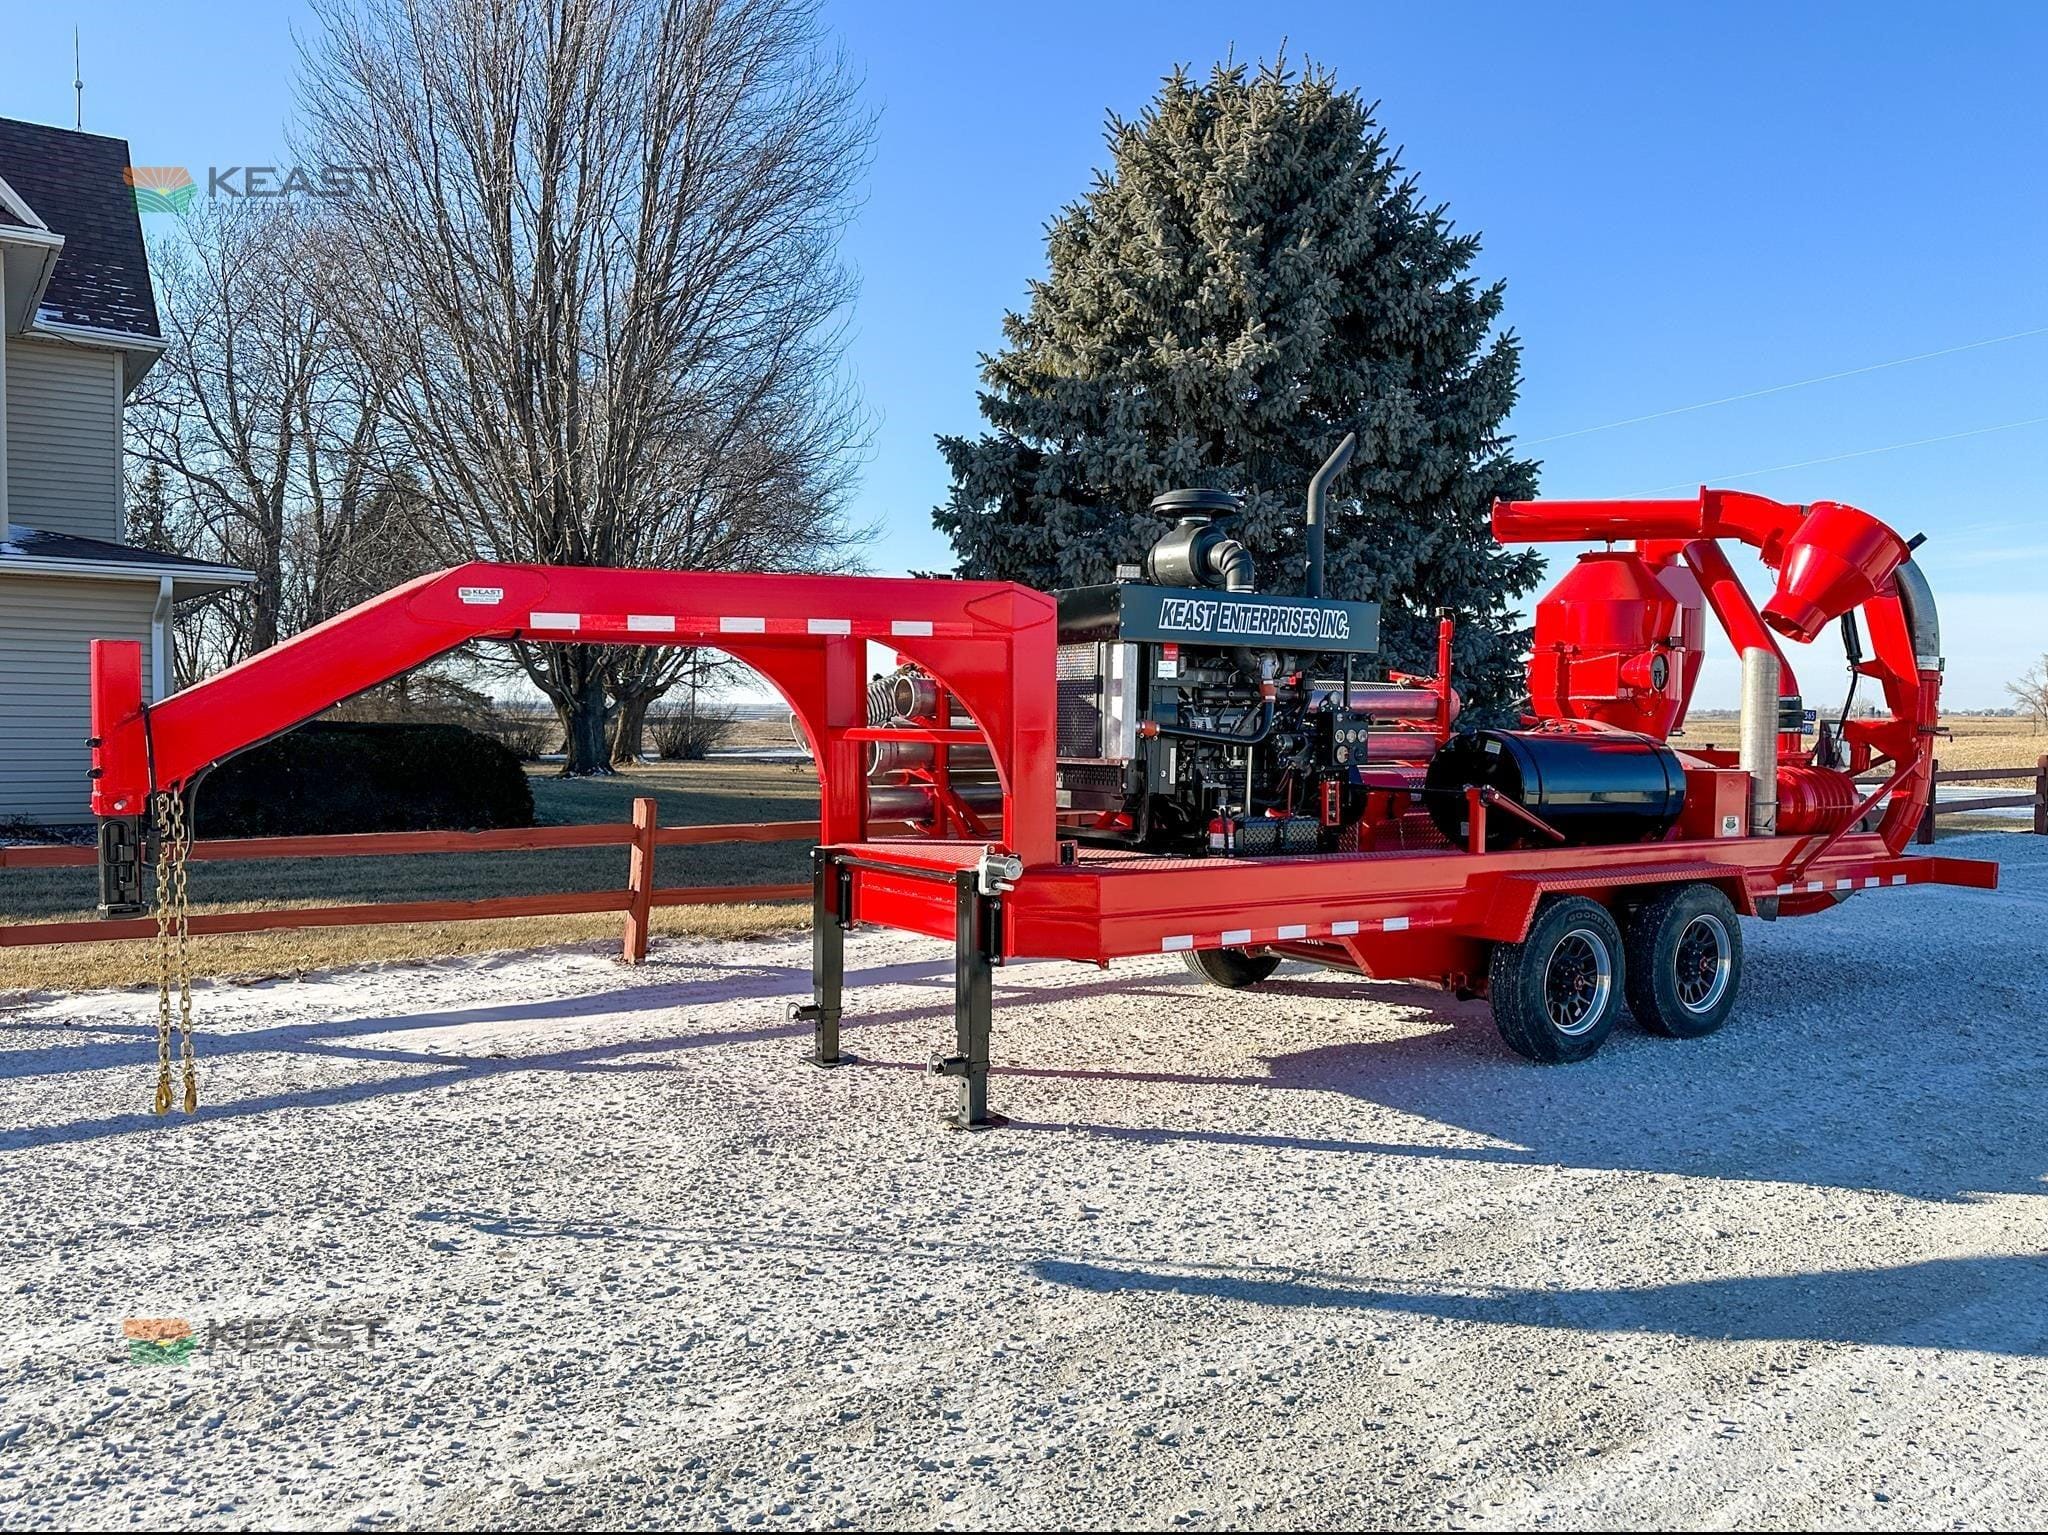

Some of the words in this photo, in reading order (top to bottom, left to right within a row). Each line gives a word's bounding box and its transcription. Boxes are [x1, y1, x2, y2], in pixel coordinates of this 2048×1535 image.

[1158, 598, 1217, 632] KEAST
[1217, 602, 1320, 637] ENTERPRISES
[1321, 609, 1349, 640] INC.
